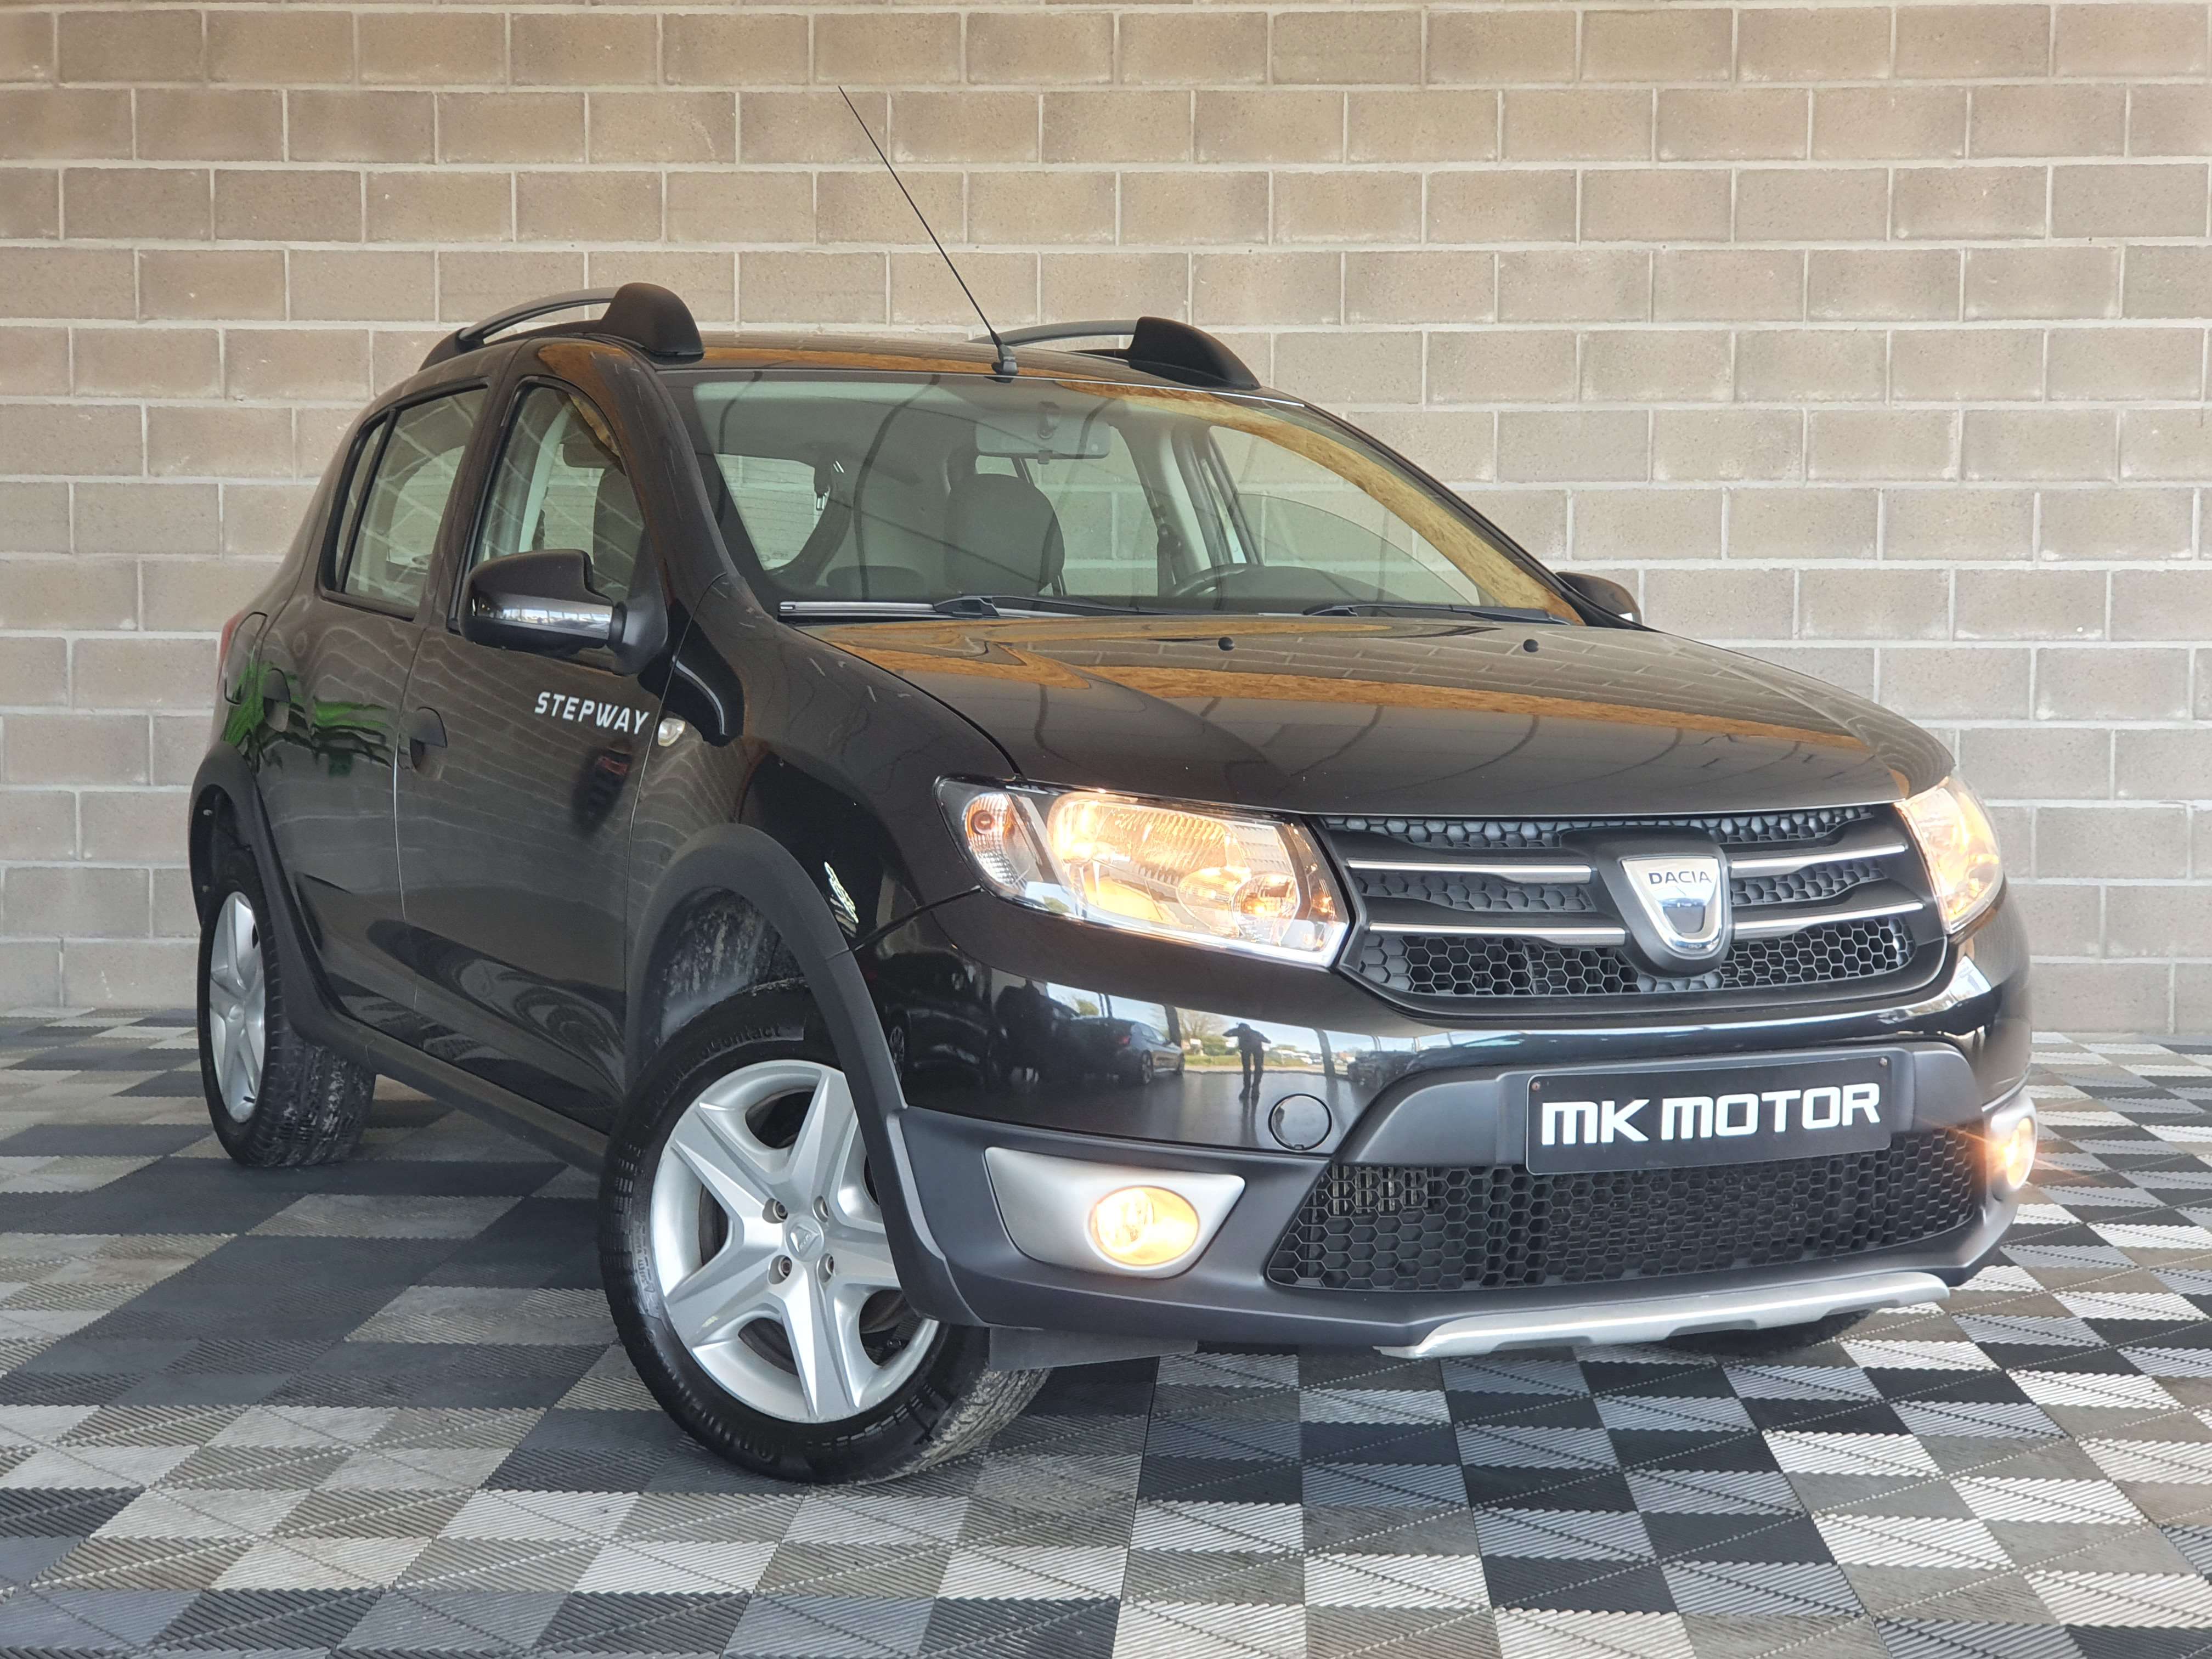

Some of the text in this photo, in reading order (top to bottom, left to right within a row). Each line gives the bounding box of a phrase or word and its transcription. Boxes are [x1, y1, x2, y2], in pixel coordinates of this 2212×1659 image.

[534, 691, 650, 735] STEPWAY
[1648, 871, 1712, 885] DACIA
[1541, 1082, 1881, 1146] MK MOTOR
